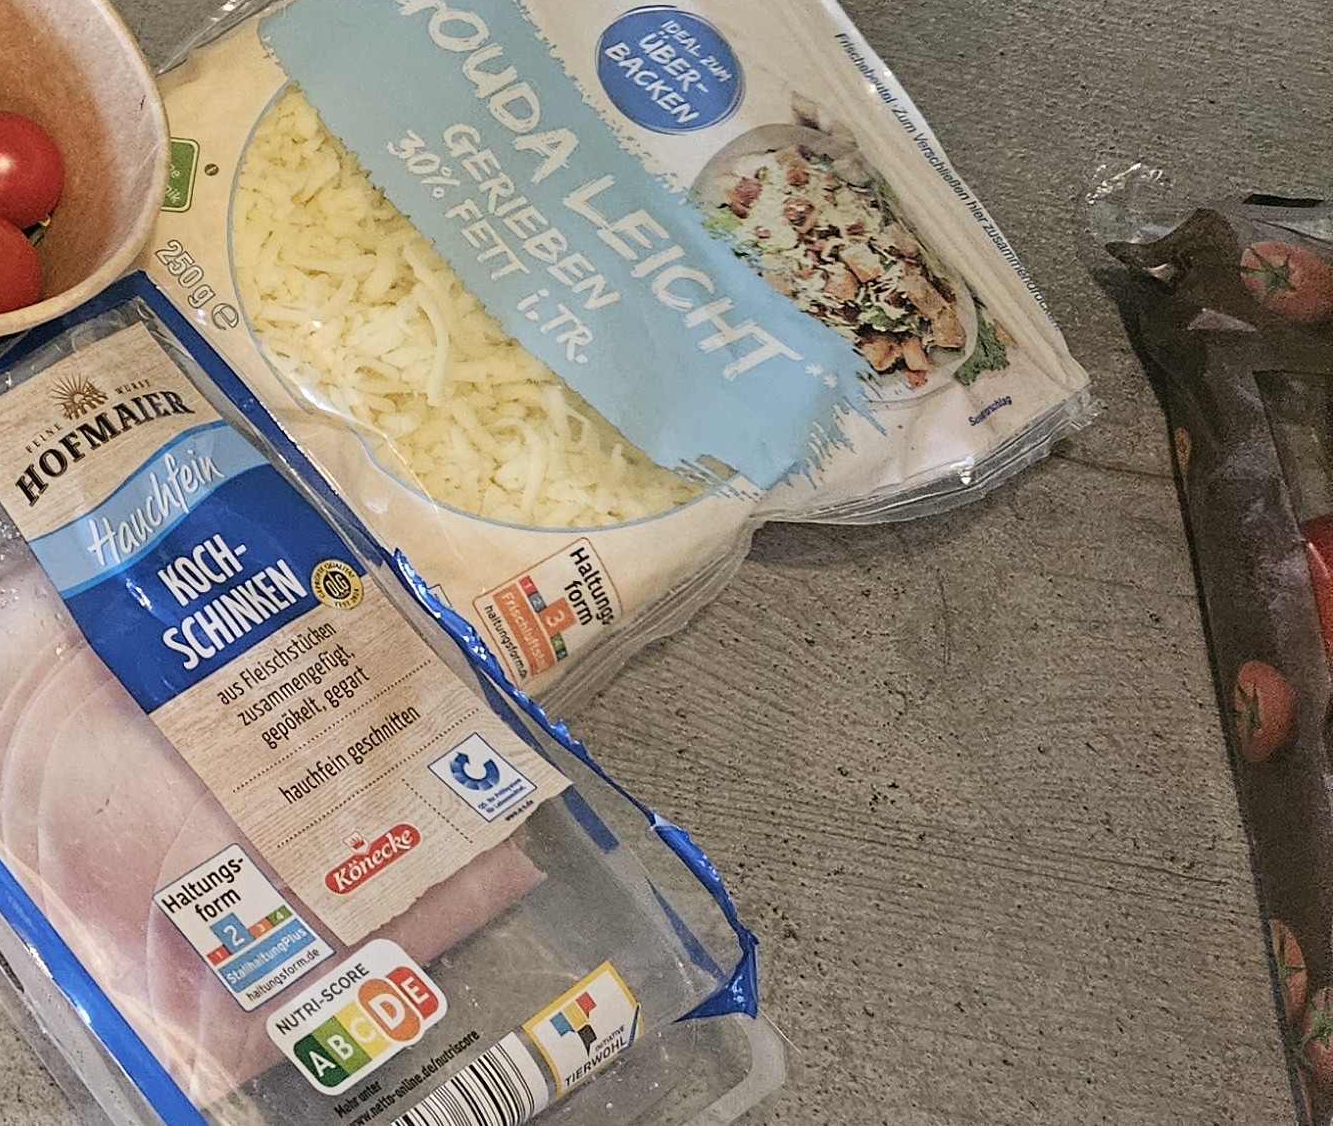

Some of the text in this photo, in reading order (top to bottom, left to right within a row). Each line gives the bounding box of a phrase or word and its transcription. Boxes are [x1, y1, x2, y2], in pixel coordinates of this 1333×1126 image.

[605, 42, 699, 124] BACKEN
[638, 31, 709, 93] ÜBER-
[661, 19, 732, 83] IDEAL ZUM
[891, 105, 917, 134] Zum
[913, 132, 970, 203] Verschließen
[966, 199, 989, 224] hier
[386, 129, 460, 200] 30%
[443, 196, 531, 281] FETT
[443, 123, 622, 312] GERIEBEN
[155, 239, 216, 309] 250 g
[15, 390, 196, 507] HOFMAIER
[25, 378, 152, 454] FEINE WURST
[86, 448, 225, 567] Hauchfein
[157, 533, 247, 607] KOCH-
[564, 580, 594, 626] form
[162, 558, 308, 670] SCHINKEN
[217, 622, 337, 706] aus Fleischstücken
[237, 645, 356, 727] zusammengefügt,
[261, 664, 371, 750] gepökelt, gegart
[278, 706, 421, 805] hauchfein geschnitten
[161, 857, 244, 914] Haltungs-
[332, 828, 414, 892] Könecke
[195, 888, 242, 922] form
[223, 925, 245, 947] 2
[226, 928, 308, 985] StallhaltungPlus
[246, 947, 321, 1002] haltungsform.de
[275, 963, 370, 1036] NUTRI-SCORE
[367, 976, 430, 1031] D E
[564, 1036, 627, 1087] TIERWOHL
[595, 1024, 625, 1052] INITIATIVE
[334, 1079, 383, 1119] Mehr unter
